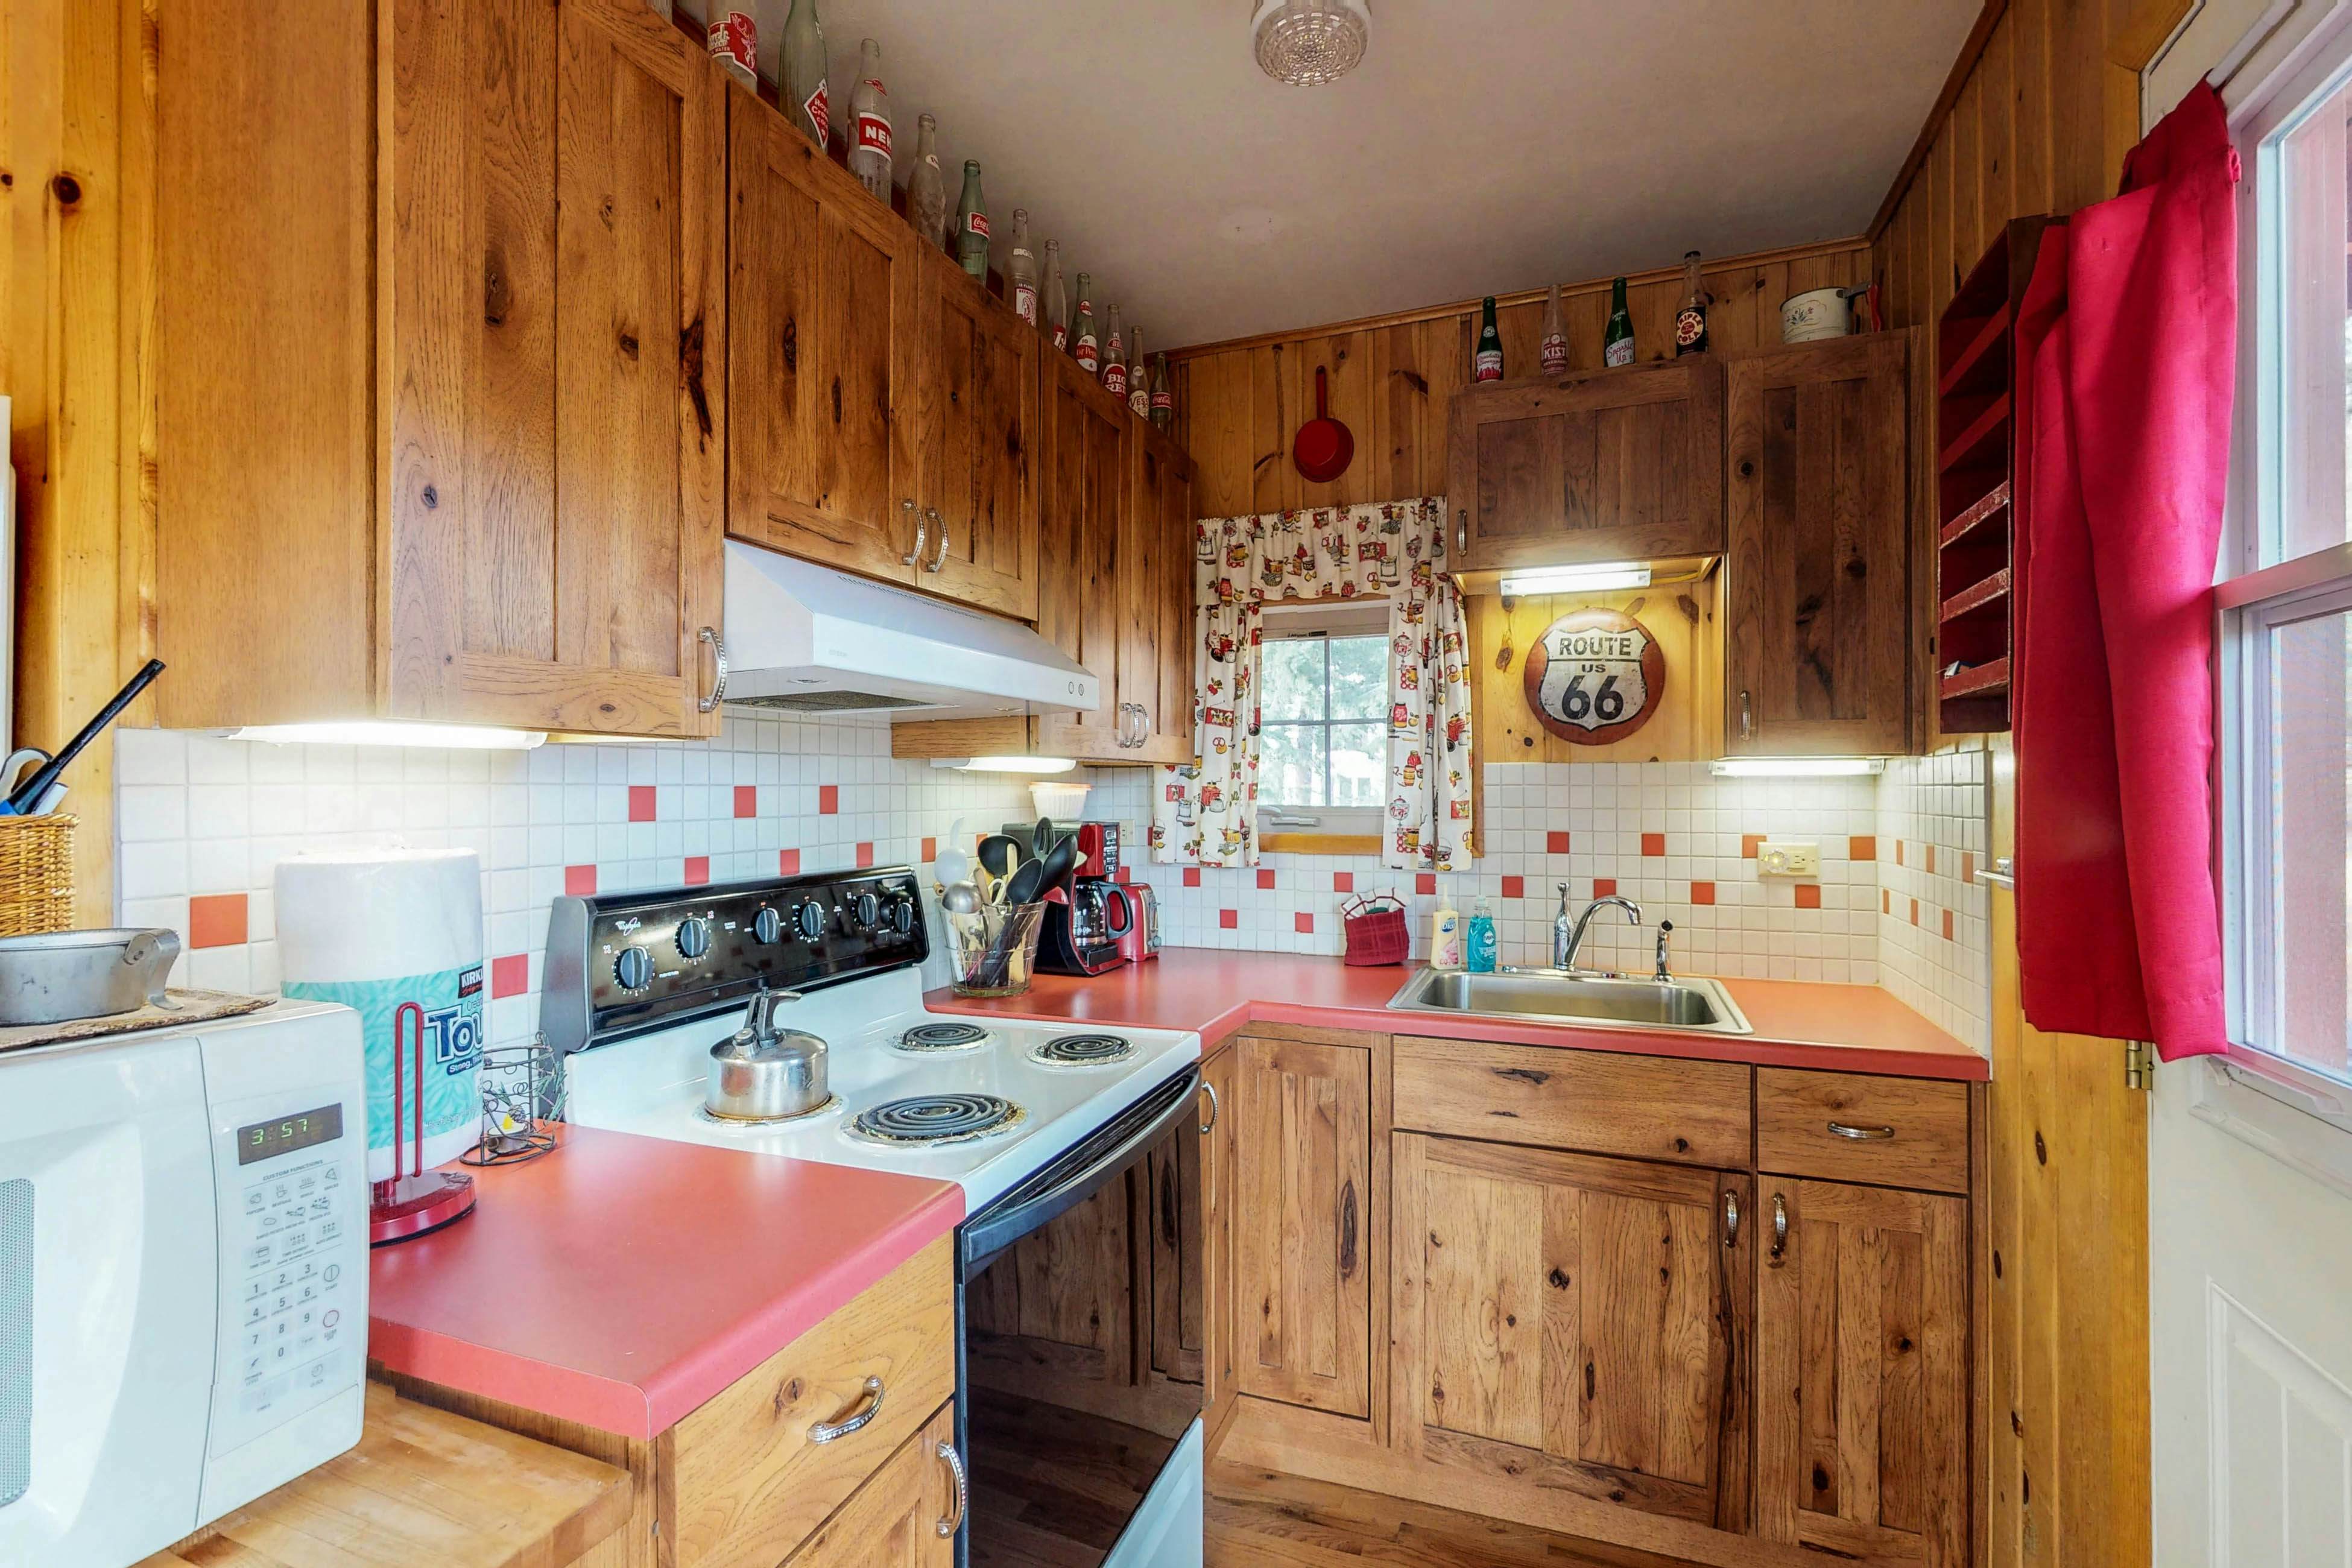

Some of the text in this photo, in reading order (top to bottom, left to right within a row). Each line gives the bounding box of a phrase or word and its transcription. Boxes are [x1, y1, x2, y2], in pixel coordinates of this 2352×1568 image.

[1678, 331, 1700, 343] COLA
[1544, 346, 1566, 359] KIST
[1107, 373, 1126, 386] BIG
[1560, 637, 1631, 656] ROUTE
[1581, 664, 1606, 673] US
[1561, 675, 1624, 721] 66
[461, 968, 482, 988] KIRK
[305, 1264, 311, 1274] 3
[280, 1274, 285, 1283] 2
[254, 1284, 258, 1293] 1
[305, 1287, 311, 1297] 6
[279, 1297, 285, 1307] 5
[253, 1307, 259, 1317] 4
[304, 1313, 310, 1323] 9
[279, 1323, 285, 1333] 8
[253, 1334, 258, 1344] 7
[278, 1347, 284, 1357] 0
